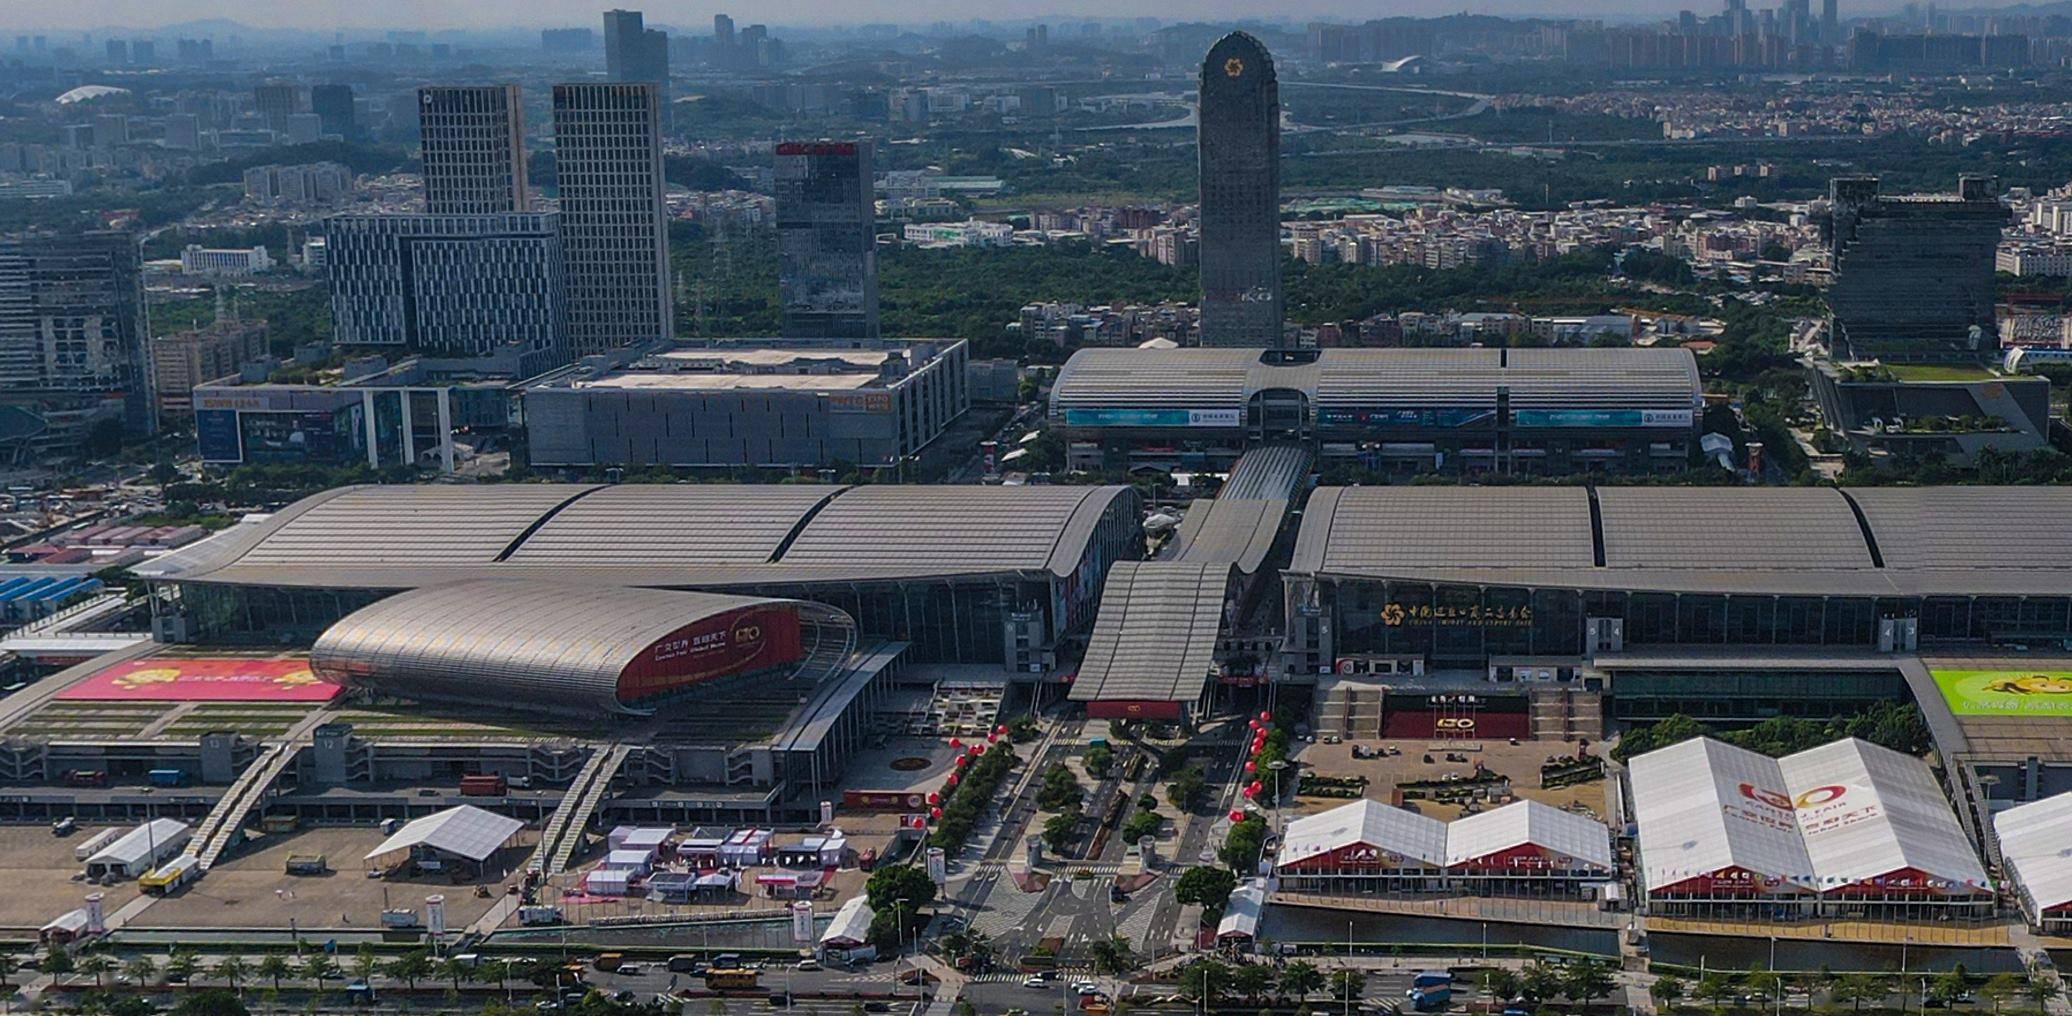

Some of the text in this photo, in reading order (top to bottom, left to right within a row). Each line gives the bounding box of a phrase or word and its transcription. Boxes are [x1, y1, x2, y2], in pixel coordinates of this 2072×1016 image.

[1321, 625, 1328, 634] 5
[1613, 627, 1619, 636] 4
[1884, 628, 1891, 637] 4
[323, 740, 333, 749] 12
